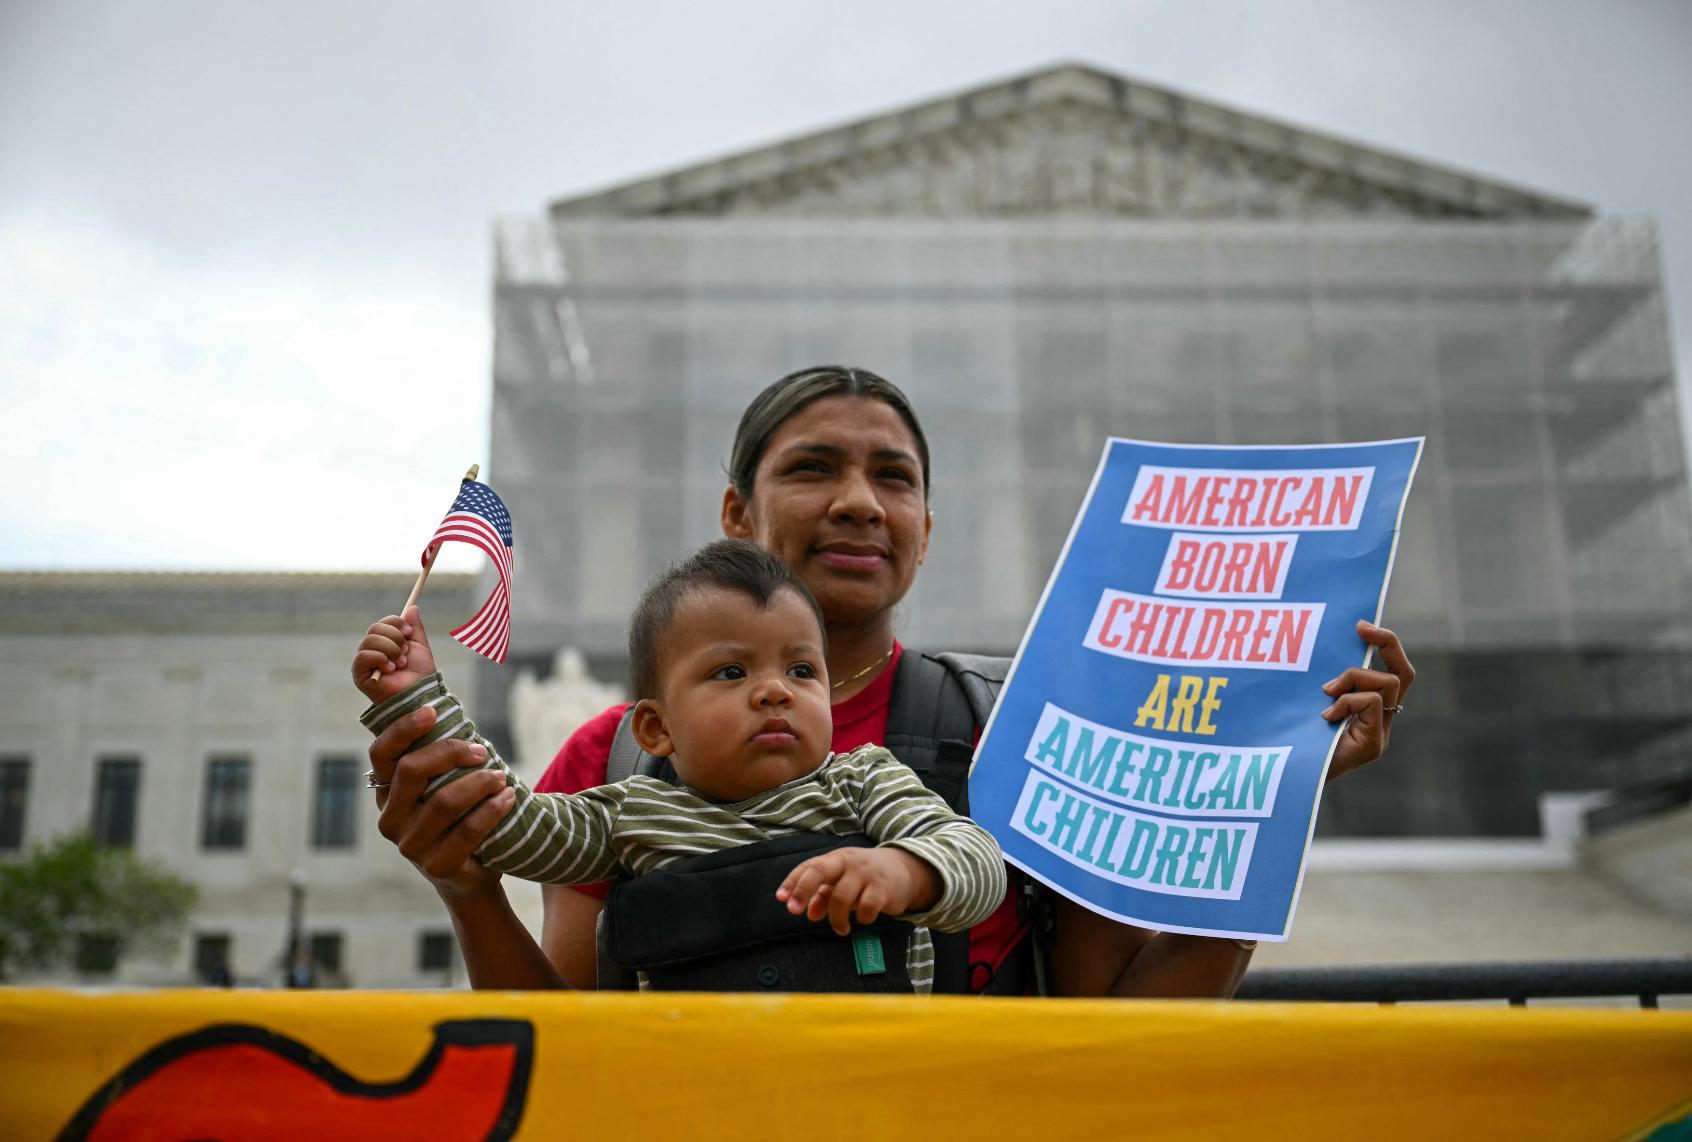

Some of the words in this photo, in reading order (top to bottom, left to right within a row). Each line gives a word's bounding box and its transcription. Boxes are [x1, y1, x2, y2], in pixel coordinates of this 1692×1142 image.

[1132, 474, 1364, 527] AMERICAN
[1163, 540, 1287, 593] BORN
[1098, 597, 1312, 663] CHILDREN
[1134, 674, 1228, 735] ARE
[1035, 715, 1279, 812] AMERICAN
[1025, 781, 1246, 892] CHILDREN
